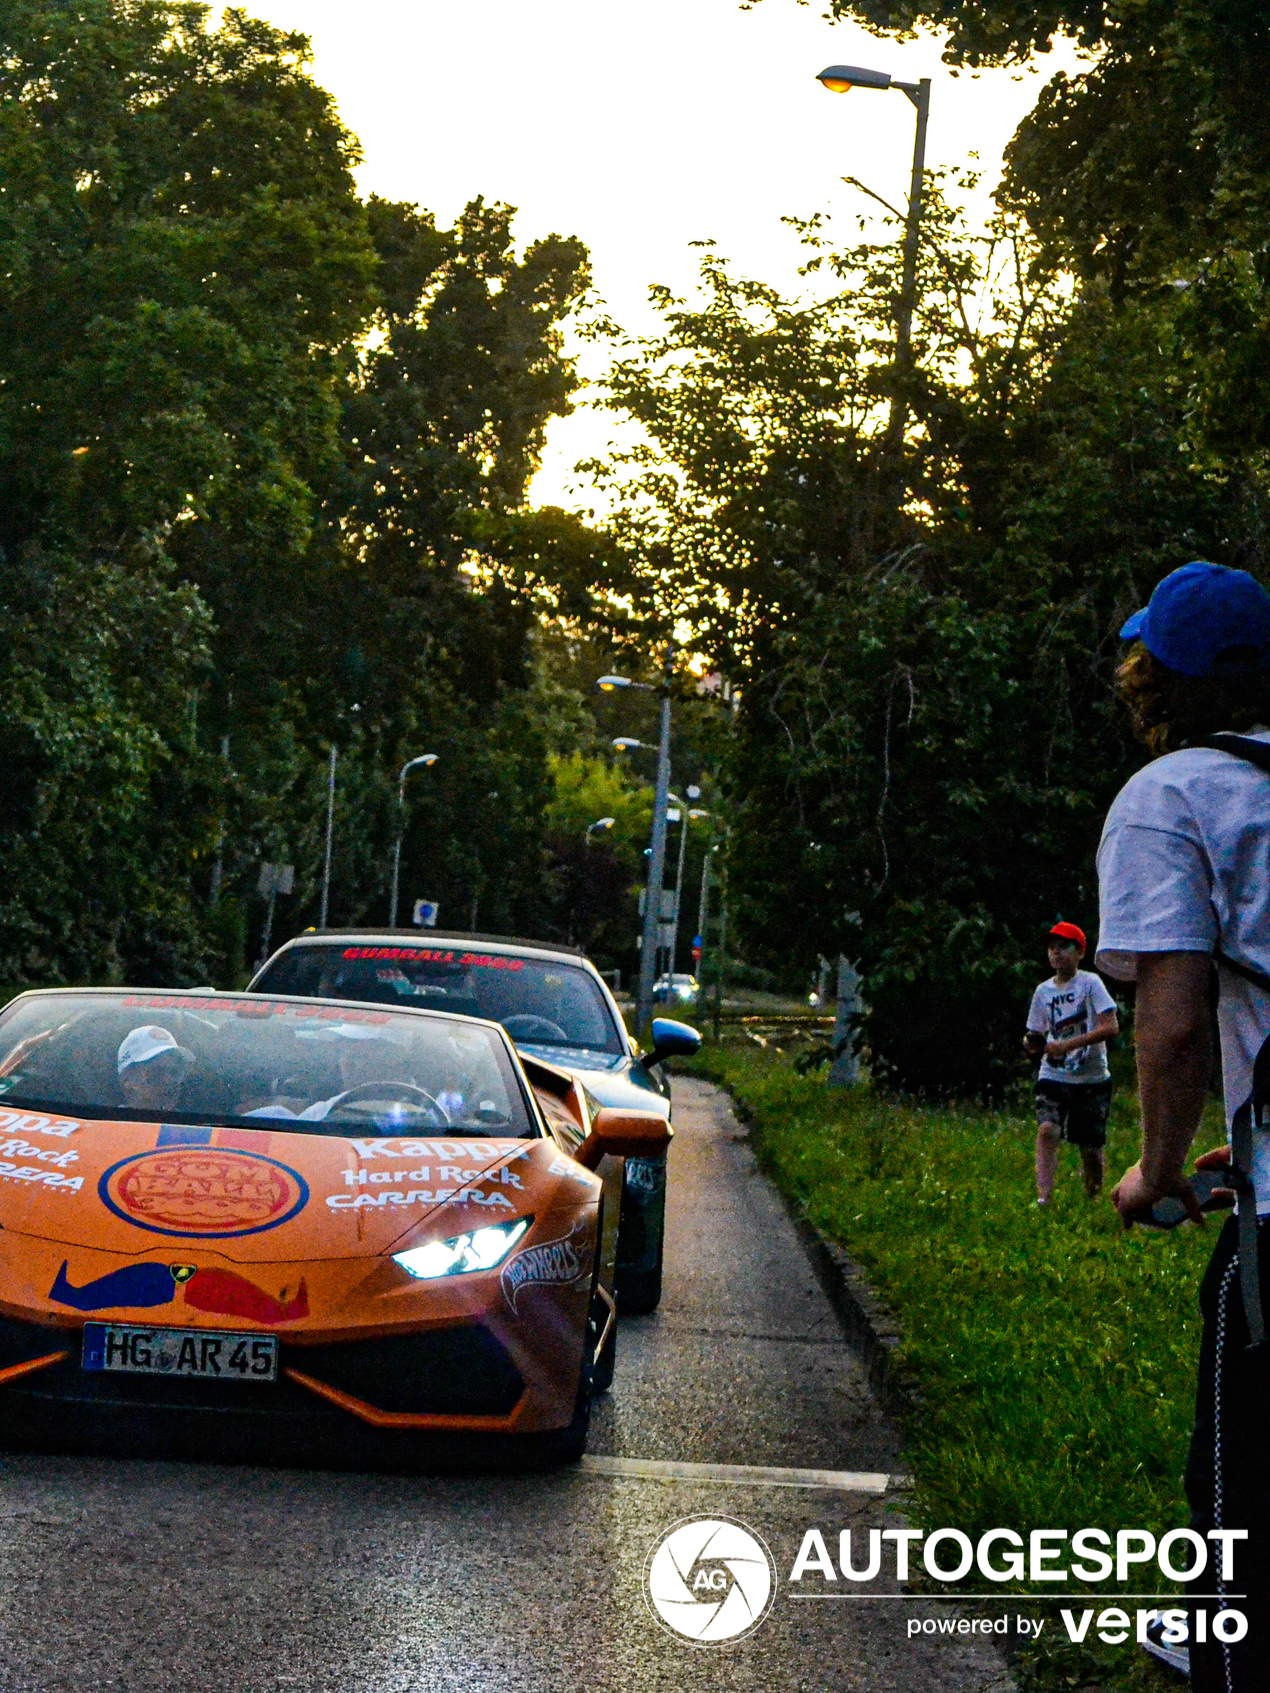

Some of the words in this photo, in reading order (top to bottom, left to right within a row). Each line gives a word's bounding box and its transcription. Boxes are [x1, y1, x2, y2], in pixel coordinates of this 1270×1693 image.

[342, 948, 453, 963] GUMBALL
[1052, 992, 1075, 1005] NYC
[347, 1138, 531, 1162] Kappa
[341, 1166, 430, 1186] Hard
[436, 1165, 525, 1190] Rock
[325, 1188, 513, 1208] CARRERA
[106, 1331, 152, 1367] HG
[177, 1336, 222, 1373] AR
[228, 1340, 272, 1374] 45
